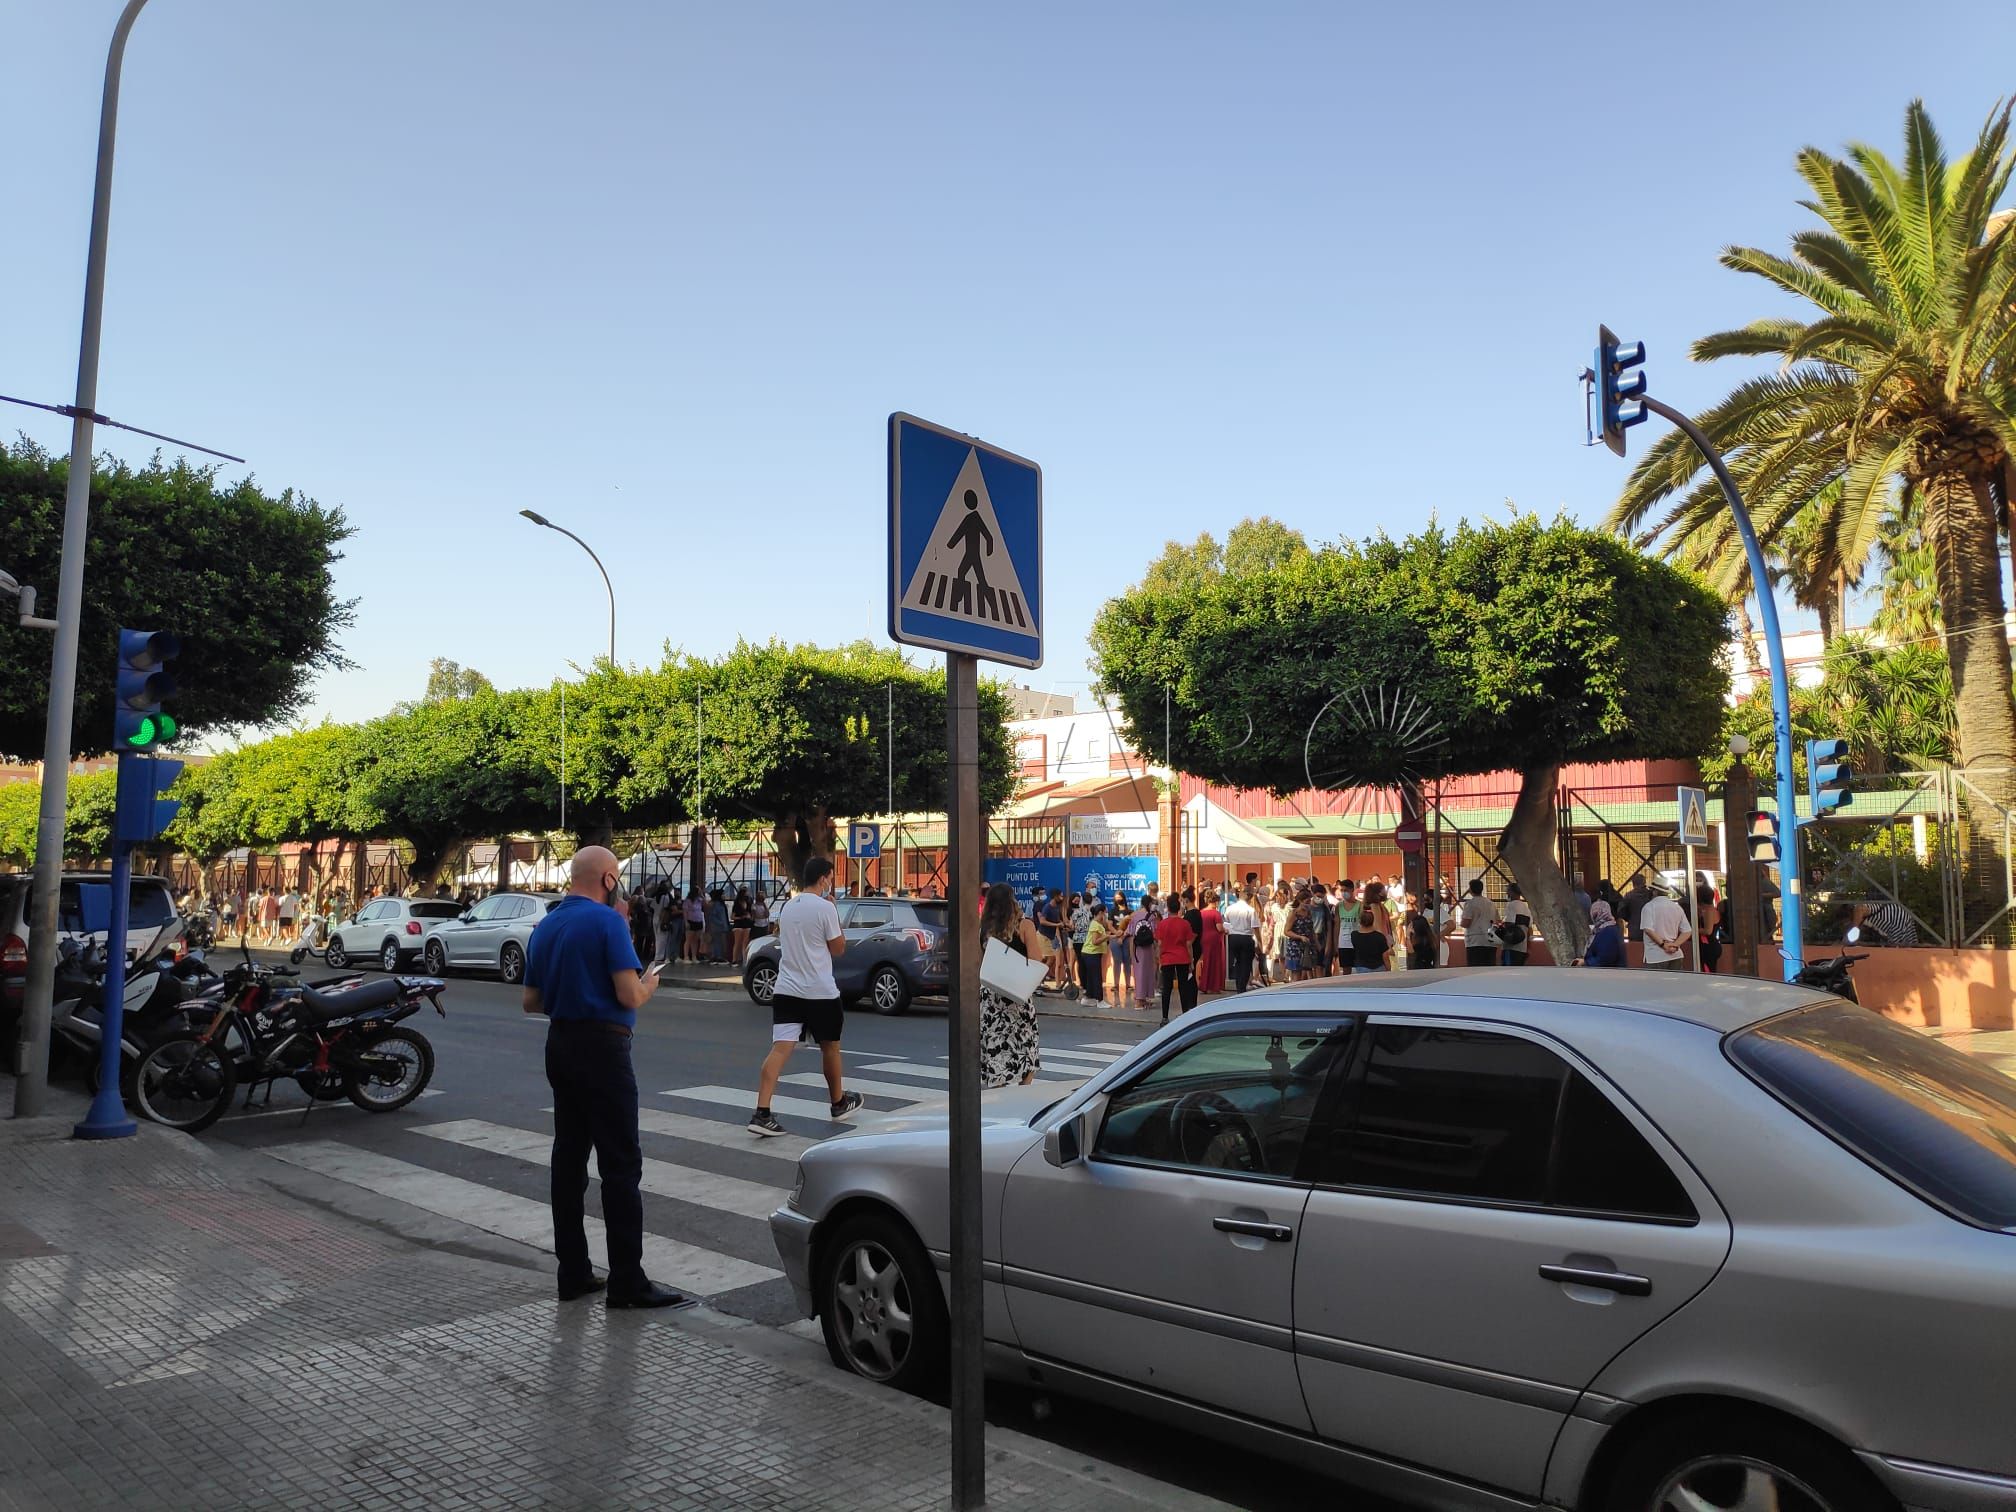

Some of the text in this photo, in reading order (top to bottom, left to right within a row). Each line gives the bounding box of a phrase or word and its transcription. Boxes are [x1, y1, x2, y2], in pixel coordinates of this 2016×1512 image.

[855, 826, 874, 854] P
[1006, 872, 1039, 881] PUNTO DE
[1104, 879, 1147, 891] MELILLA
